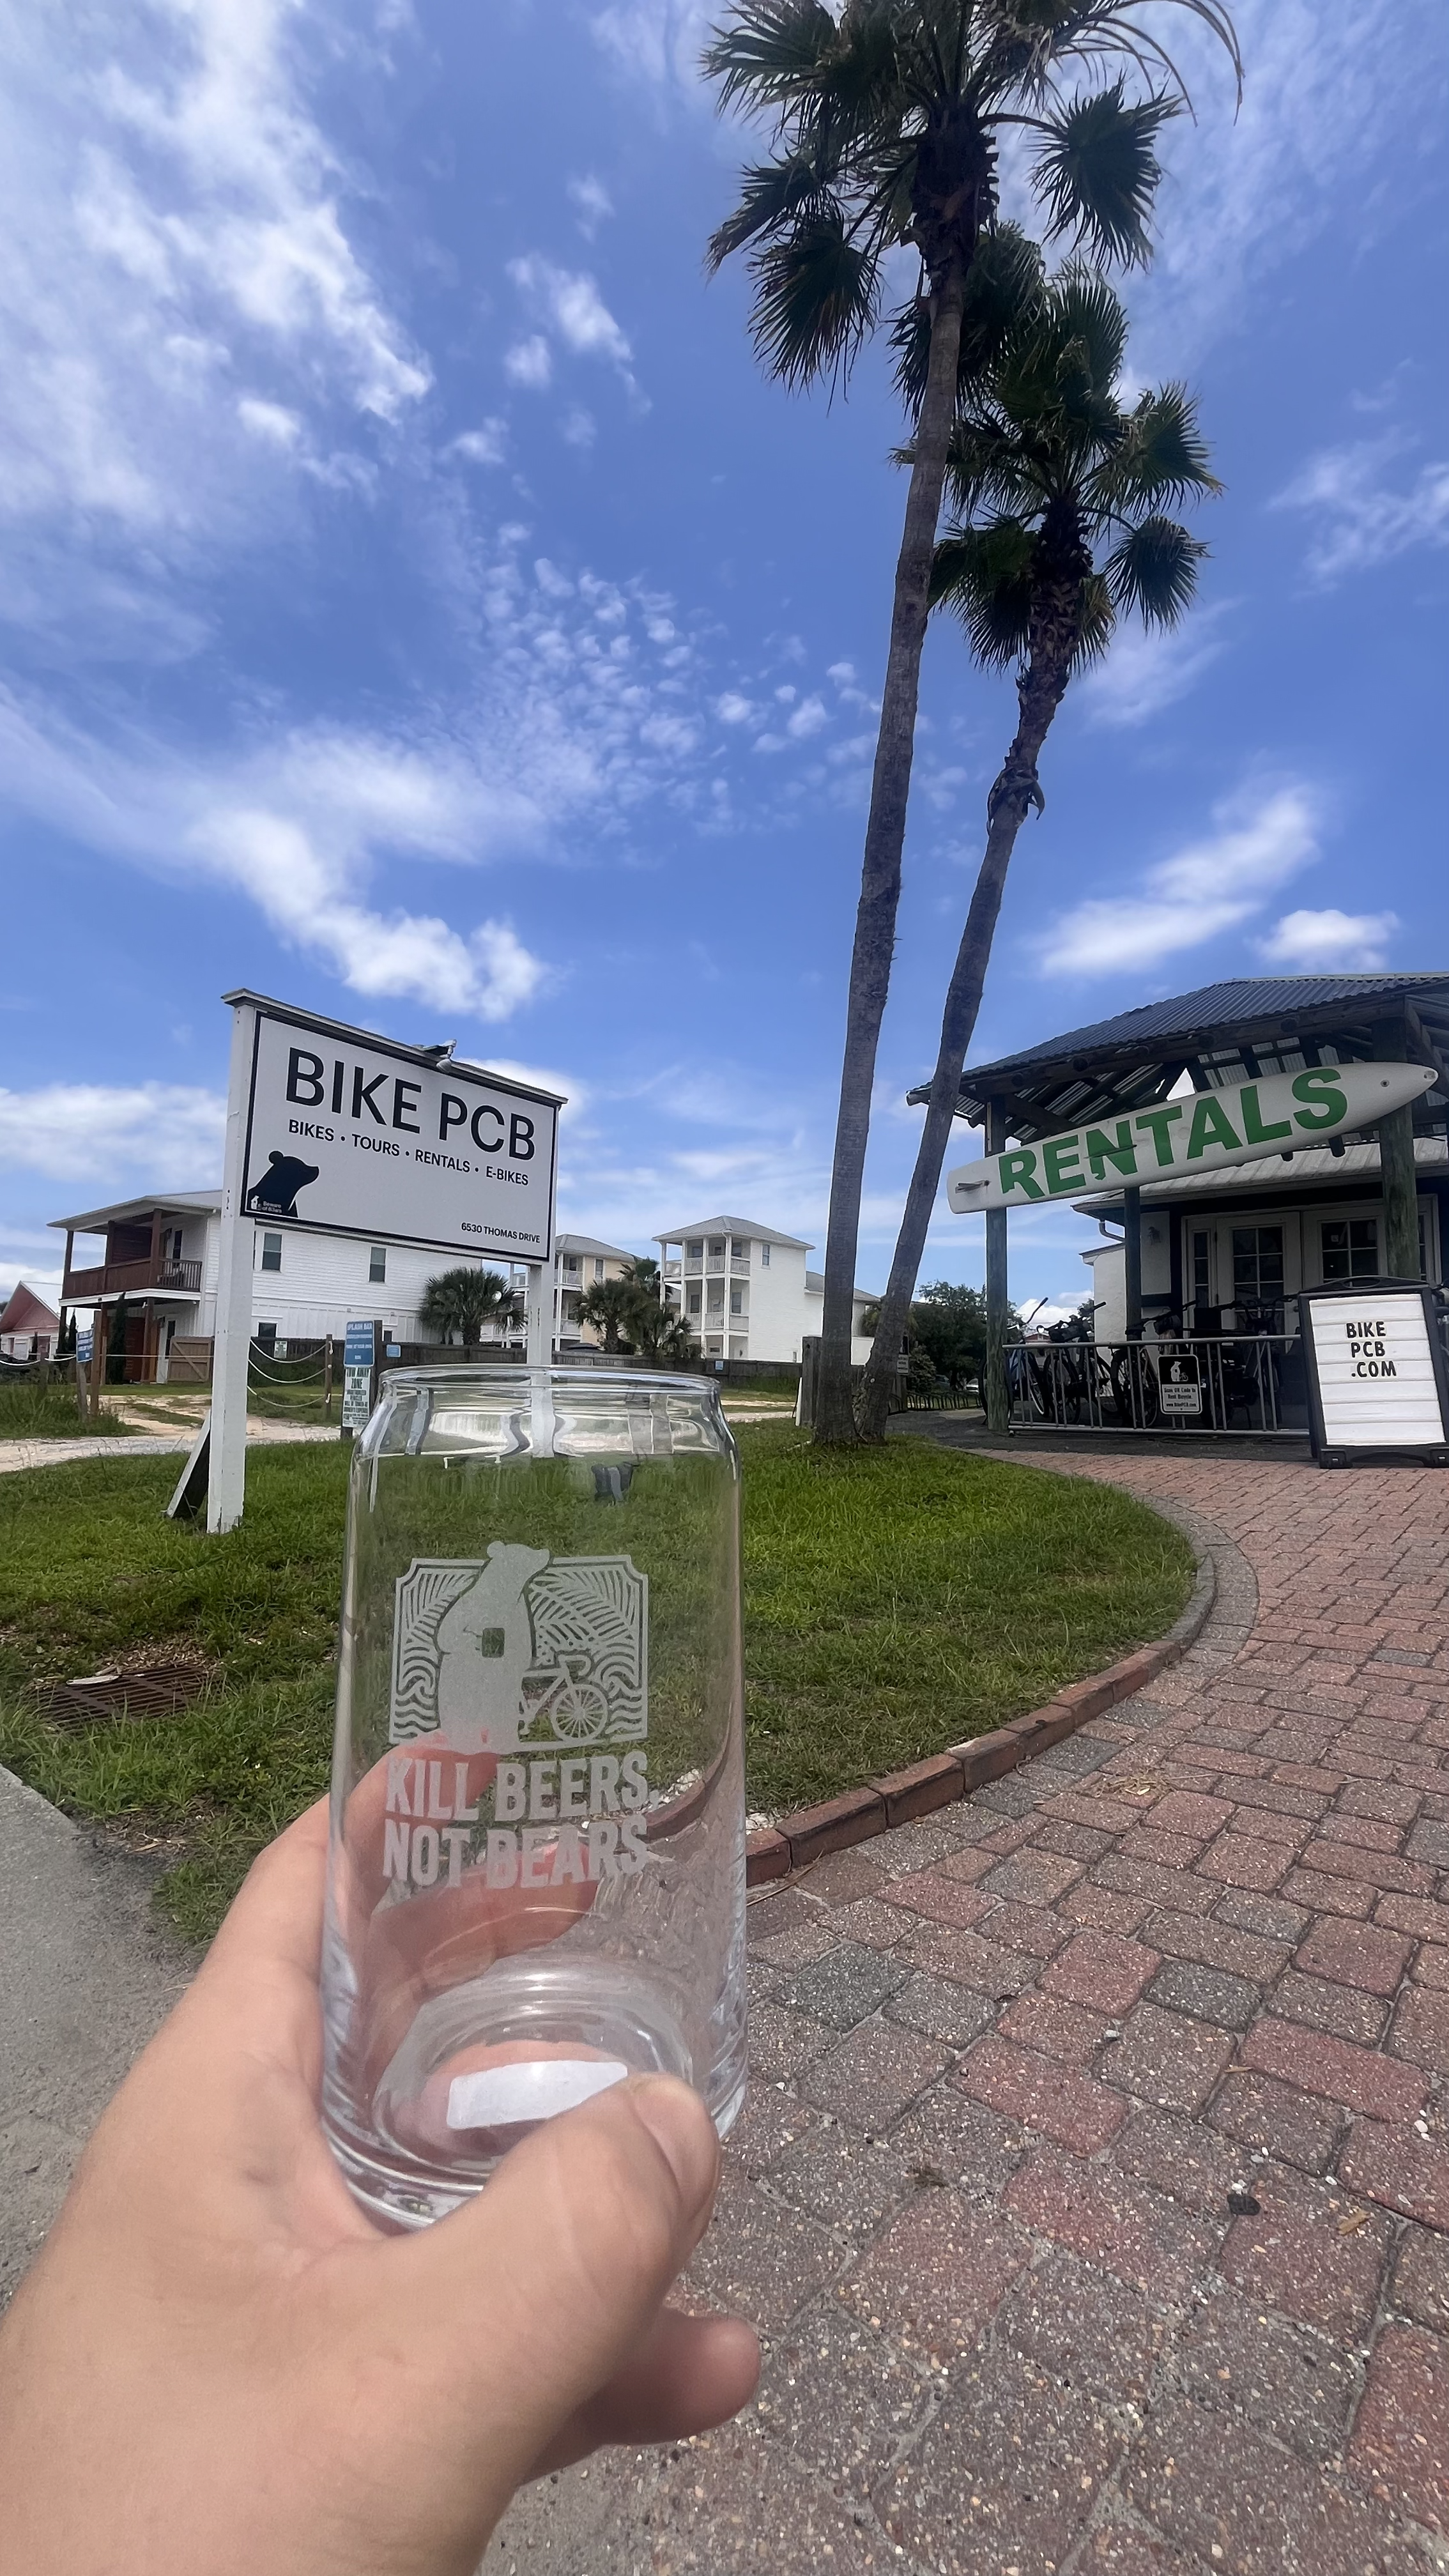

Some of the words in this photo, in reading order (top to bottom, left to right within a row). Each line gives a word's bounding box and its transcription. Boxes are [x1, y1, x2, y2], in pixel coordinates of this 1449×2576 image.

[286, 1047, 422, 1134] BIKE
[439, 1092, 536, 1161] PCB
[998, 1068, 1349, 1199] RENTALS
[289, 1119, 334, 1142] BIKES
[351, 1133, 400, 1156] TOURS
[415, 1149, 470, 1173] RENTALS
[486, 1166, 529, 1186] E-BIKES
[461, 1222, 482, 1233] 6530
[484, 1226, 518, 1239] THOMAS
[519, 1232, 540, 1243] DRIVE
[1346, 1321, 1386, 1338] BIKE
[1351, 1341, 1386, 1358] PCB
[1351, 1360, 1397, 1377] .COM
[386, 1756, 479, 1821] KILL
[383, 1818, 471, 1887] NOT
[486, 1813, 648, 1890] BEARS
